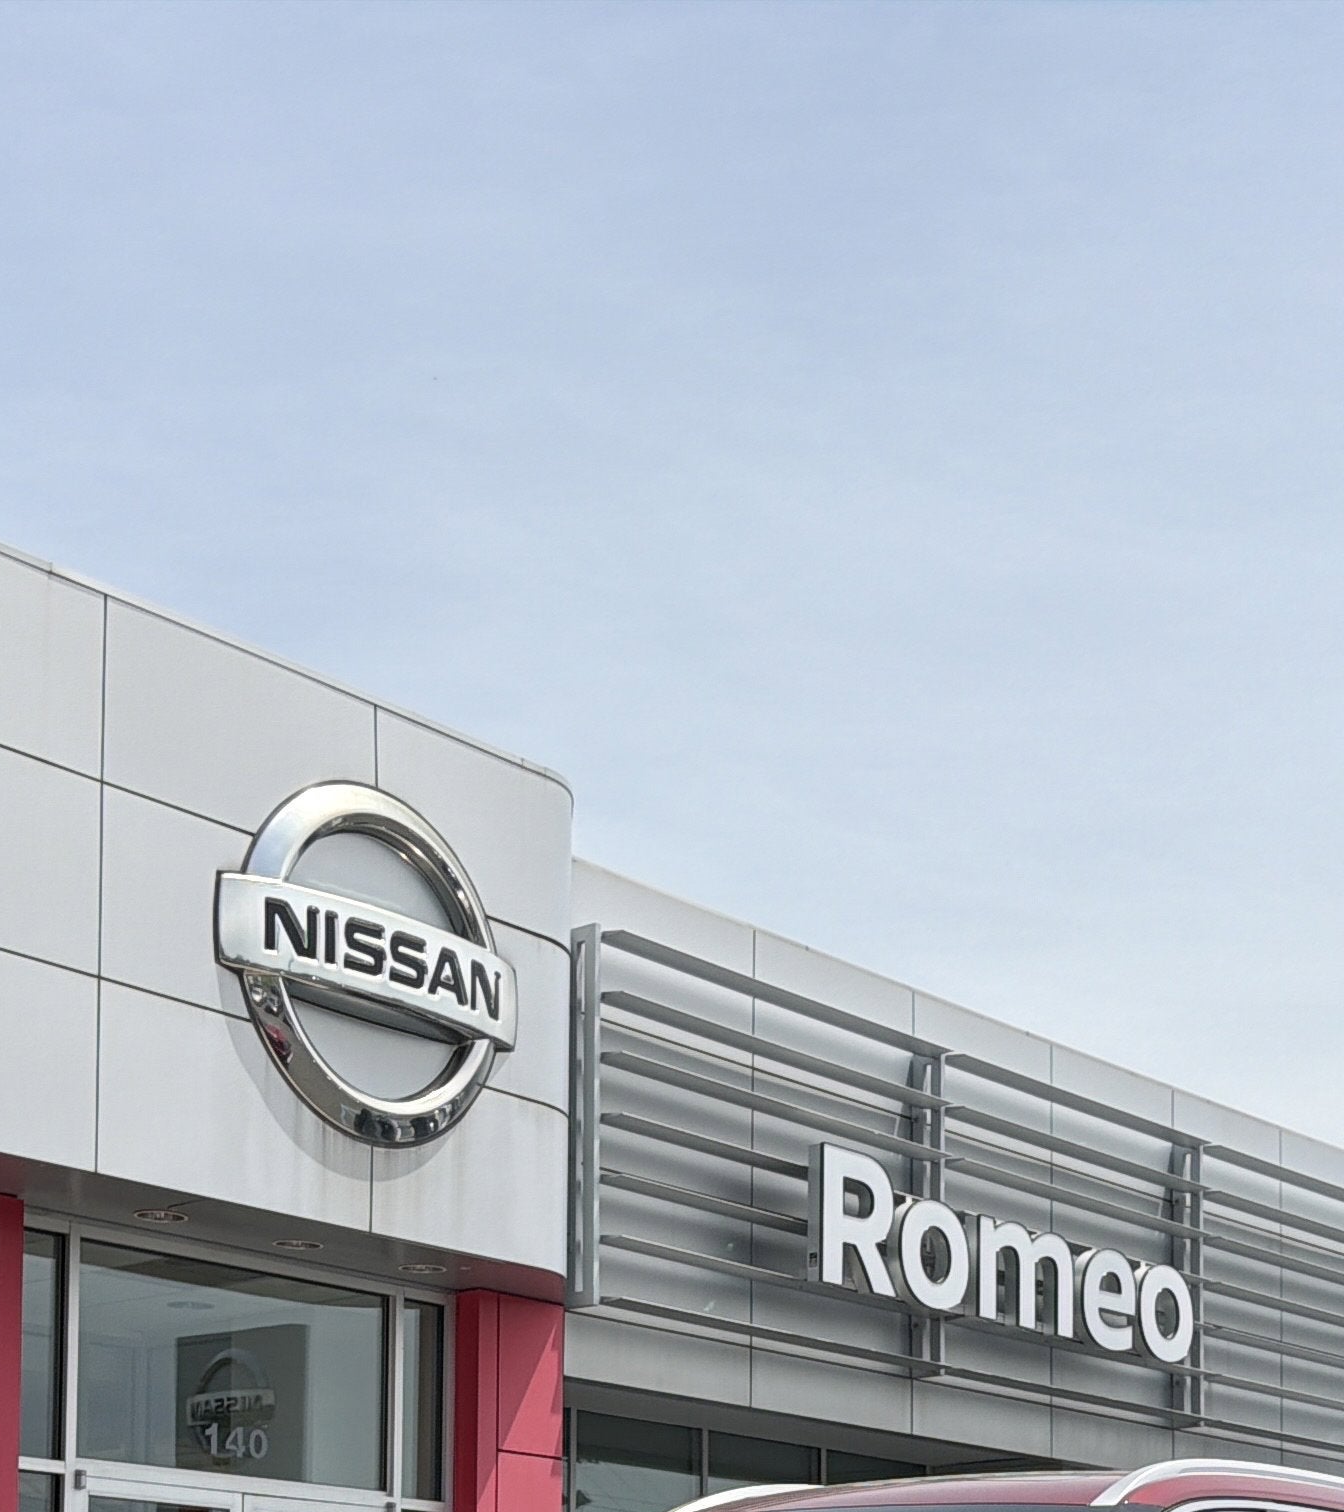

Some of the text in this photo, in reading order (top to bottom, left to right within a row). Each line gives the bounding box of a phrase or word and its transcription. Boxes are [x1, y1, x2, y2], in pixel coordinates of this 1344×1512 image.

[264, 896, 503, 1022] NISSAN
[816, 1142, 1194, 1363] Romeo
[205, 1422, 268, 1459] 140
